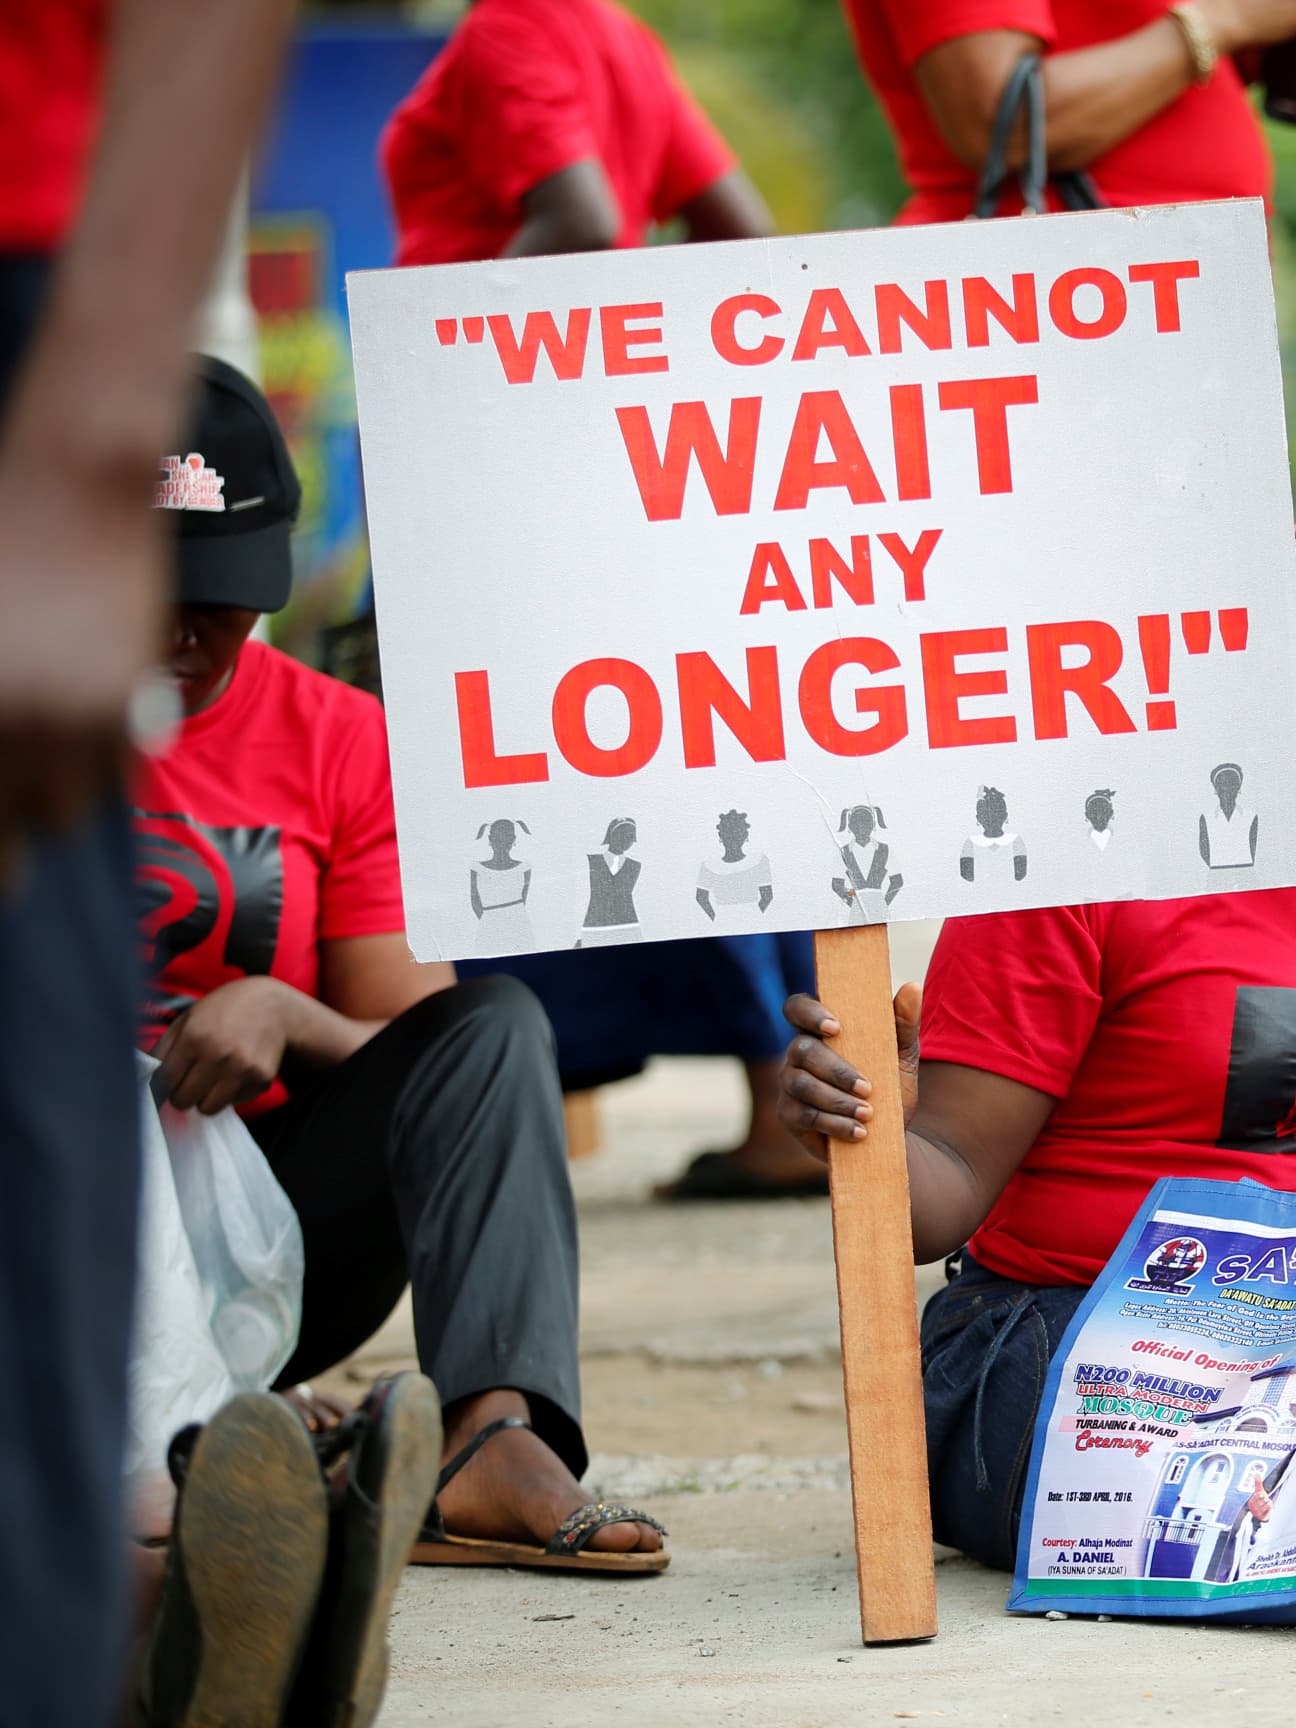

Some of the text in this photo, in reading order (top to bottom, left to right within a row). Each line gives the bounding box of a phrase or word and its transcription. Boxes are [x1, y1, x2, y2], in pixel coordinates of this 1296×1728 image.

[435, 261, 1202, 386] "WE CANNOT
[616, 375, 1040, 523] WAIT
[740, 528, 944, 617] ANY
[455, 608, 1251, 791] LONGER!"
[1238, 1307, 1255, 1317] God
[1256, 1311, 1265, 1319] is
[1131, 1340, 1282, 1373] Official Opening of
[1074, 1364, 1223, 1402] N200 MILLION
[1077, 1383, 1209, 1412] ULTRA MODERN
[1077, 1396, 1193, 1426] MOSQUE
[1075, 1419, 1178, 1438] TURBANING & AWARD
[1075, 1430, 1153, 1457] Ceremony
[1220, 1438, 1260, 1449] CENTRAL
[1092, 1492, 1112, 1503] APRIL,
[1113, 1492, 1133, 1502] 2016.
[1042, 1538, 1133, 1550] Courtesy: Alhaja Modinat
[1057, 1551, 1115, 1563] A. DANIEL
[1062, 1566, 1086, 1575] SUNNA
[1087, 1566, 1096, 1575] OF
